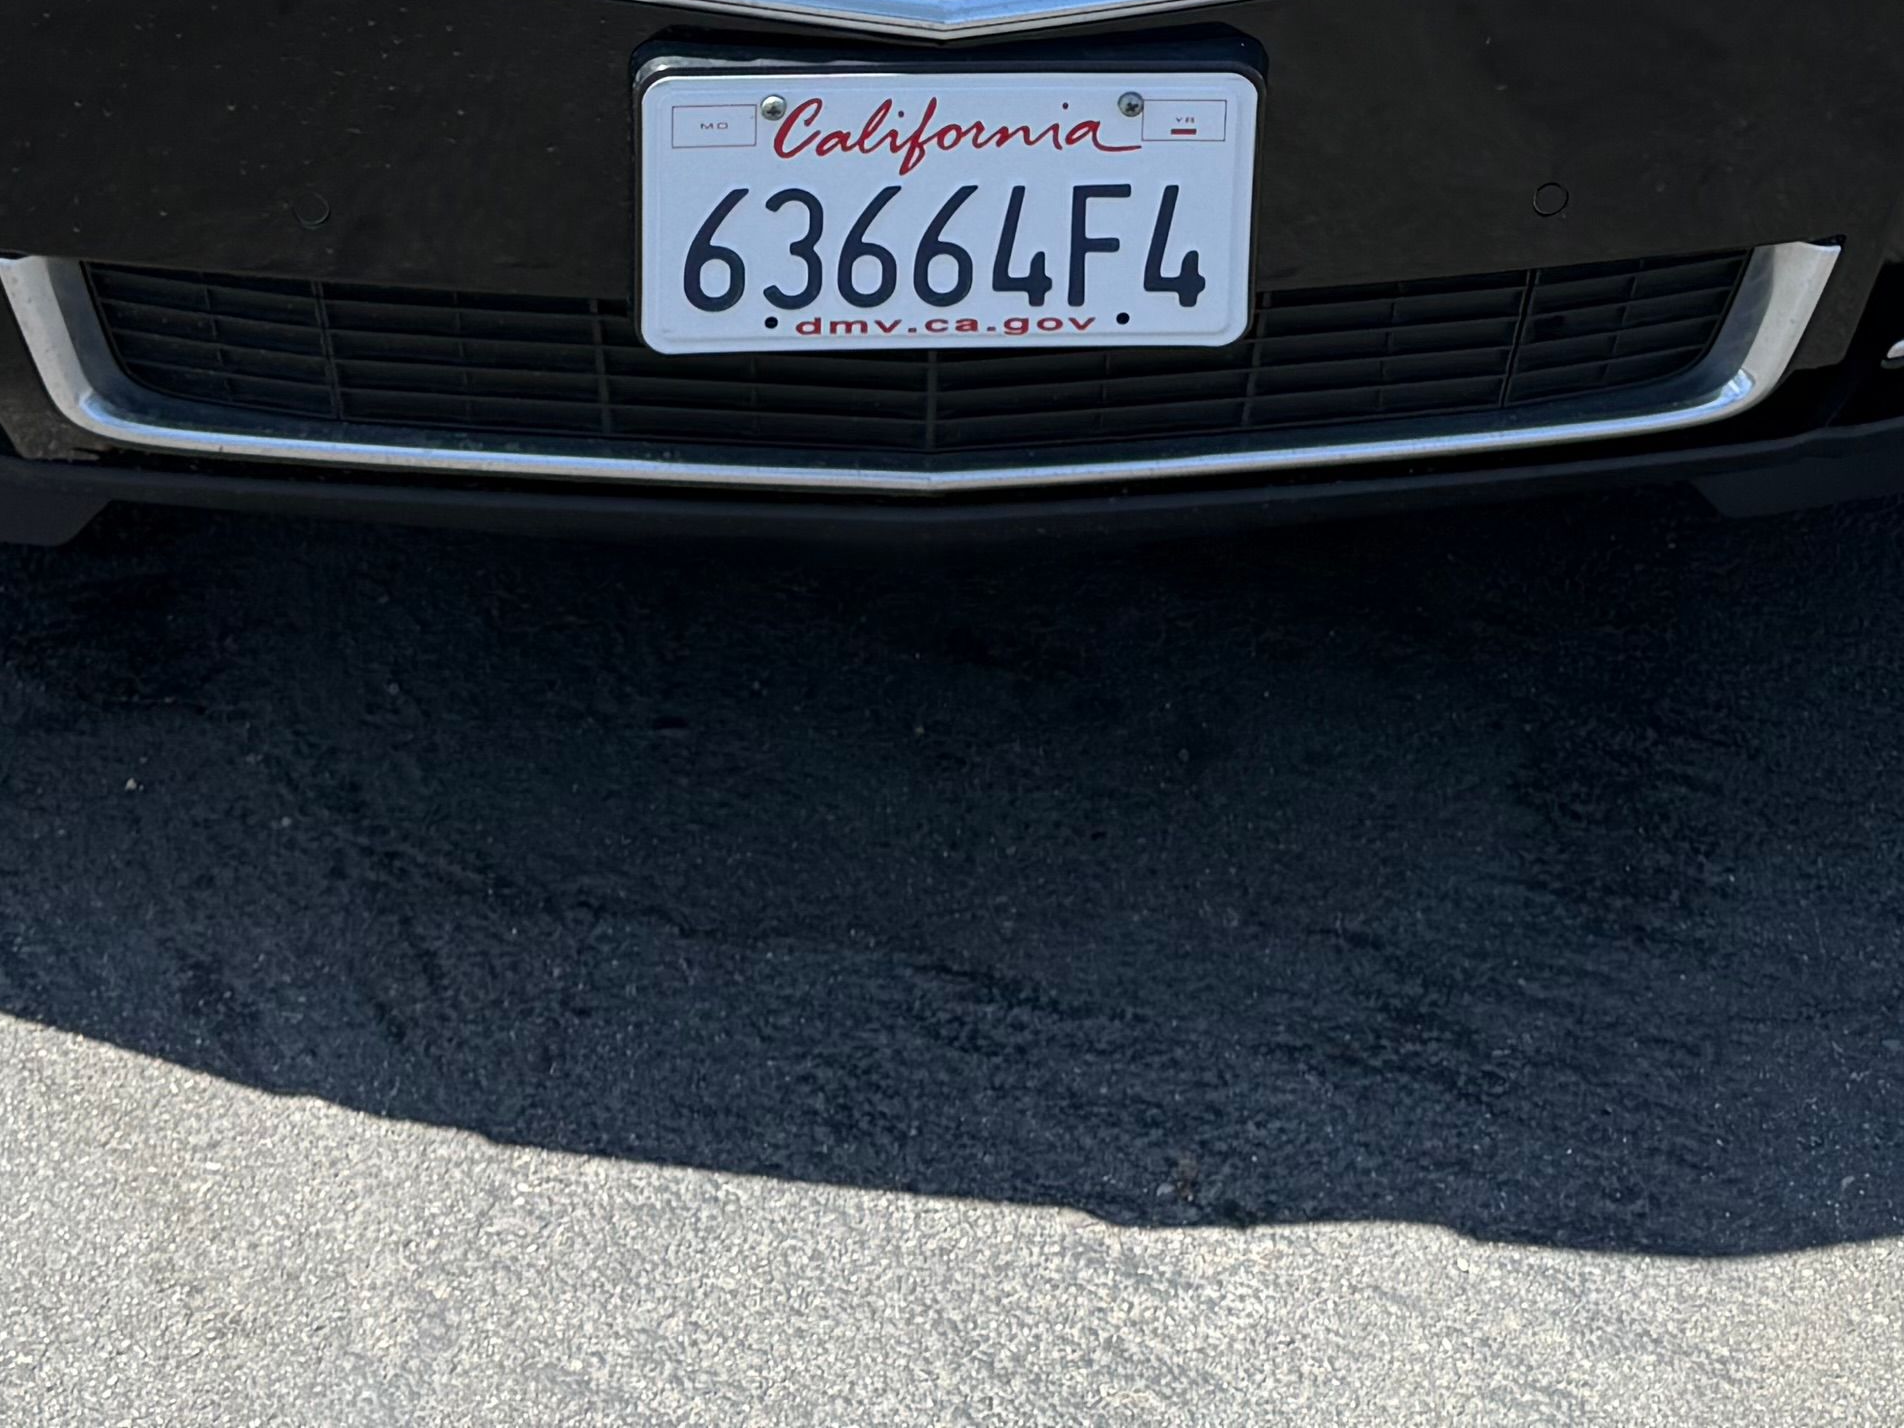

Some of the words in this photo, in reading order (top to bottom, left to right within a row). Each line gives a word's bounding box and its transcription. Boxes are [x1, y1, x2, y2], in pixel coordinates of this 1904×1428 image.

[773, 97, 1142, 174] California
[683, 184, 1206, 312] 63664F4
[795, 313, 1096, 337] dmv.ca.gov
